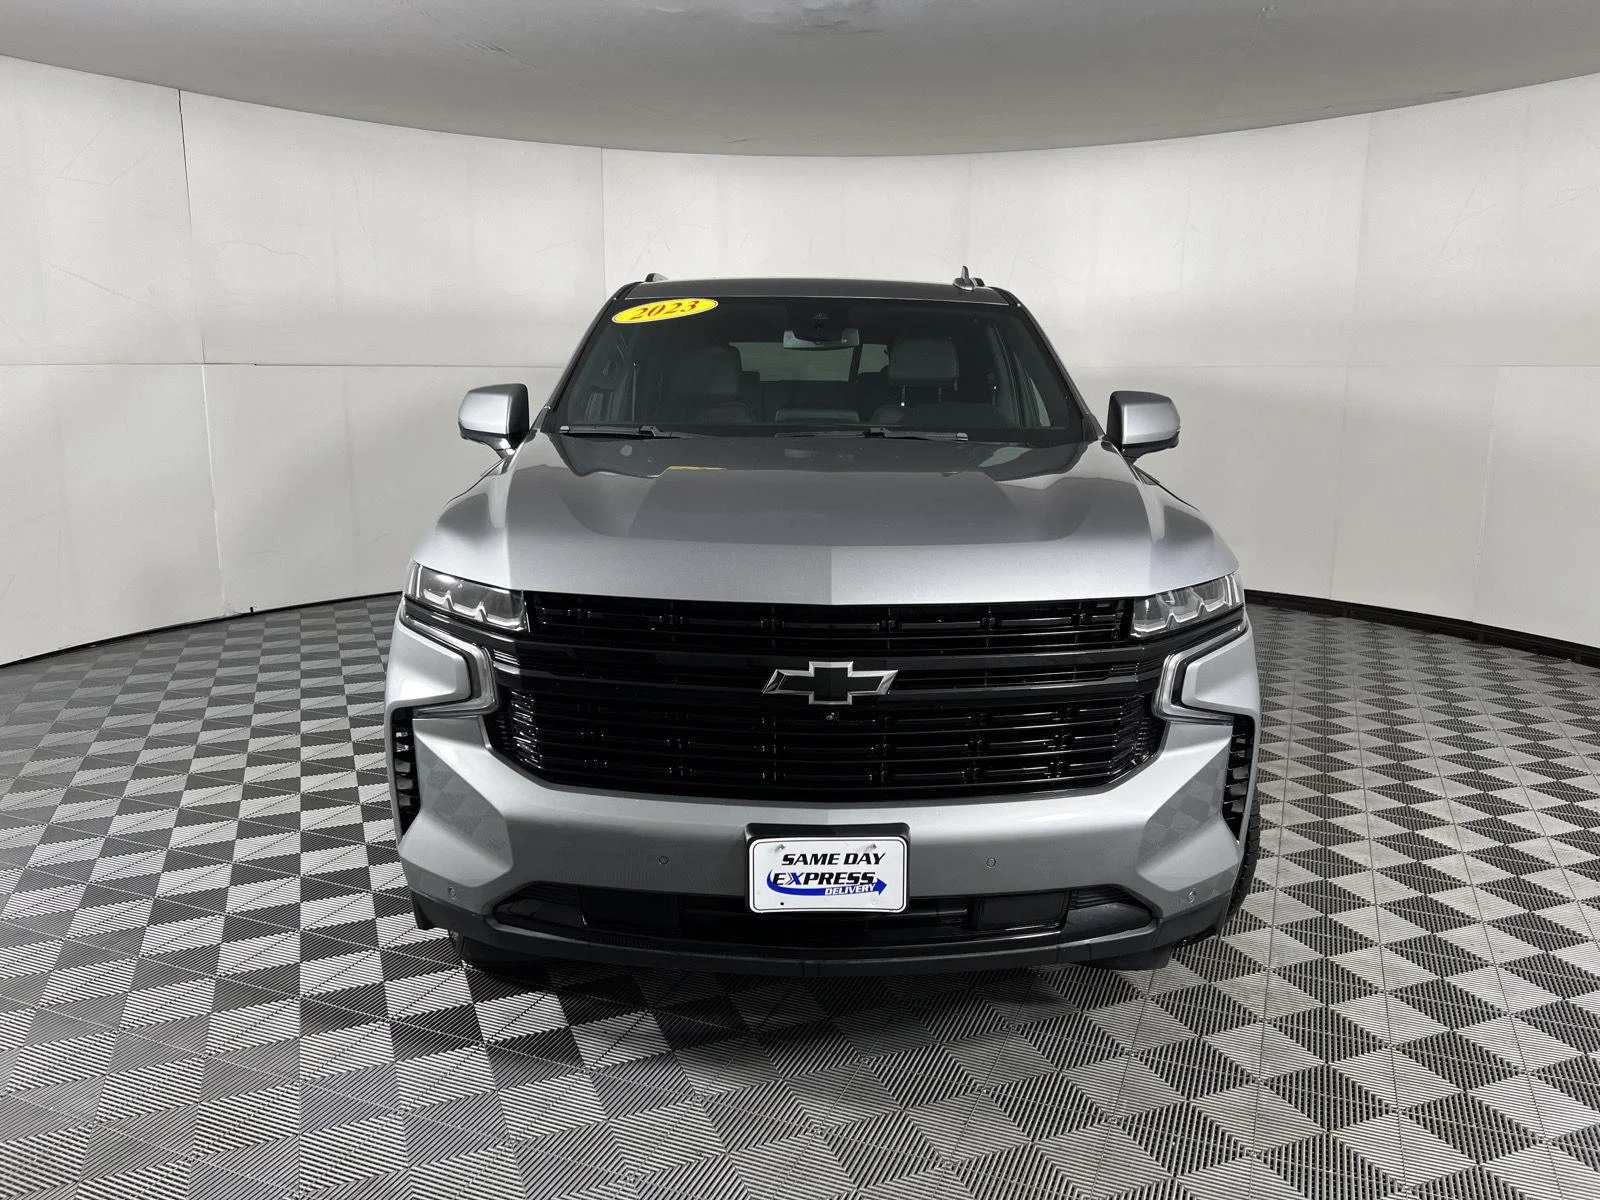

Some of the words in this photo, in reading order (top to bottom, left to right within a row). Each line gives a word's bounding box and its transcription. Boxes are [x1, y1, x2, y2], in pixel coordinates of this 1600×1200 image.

[628, 301, 700, 320] 2023
[781, 853, 841, 866] SAME
[843, 853, 886, 866] DAY
[772, 871, 876, 886] EXPRESS
[824, 883, 876, 896] DELIVERY
